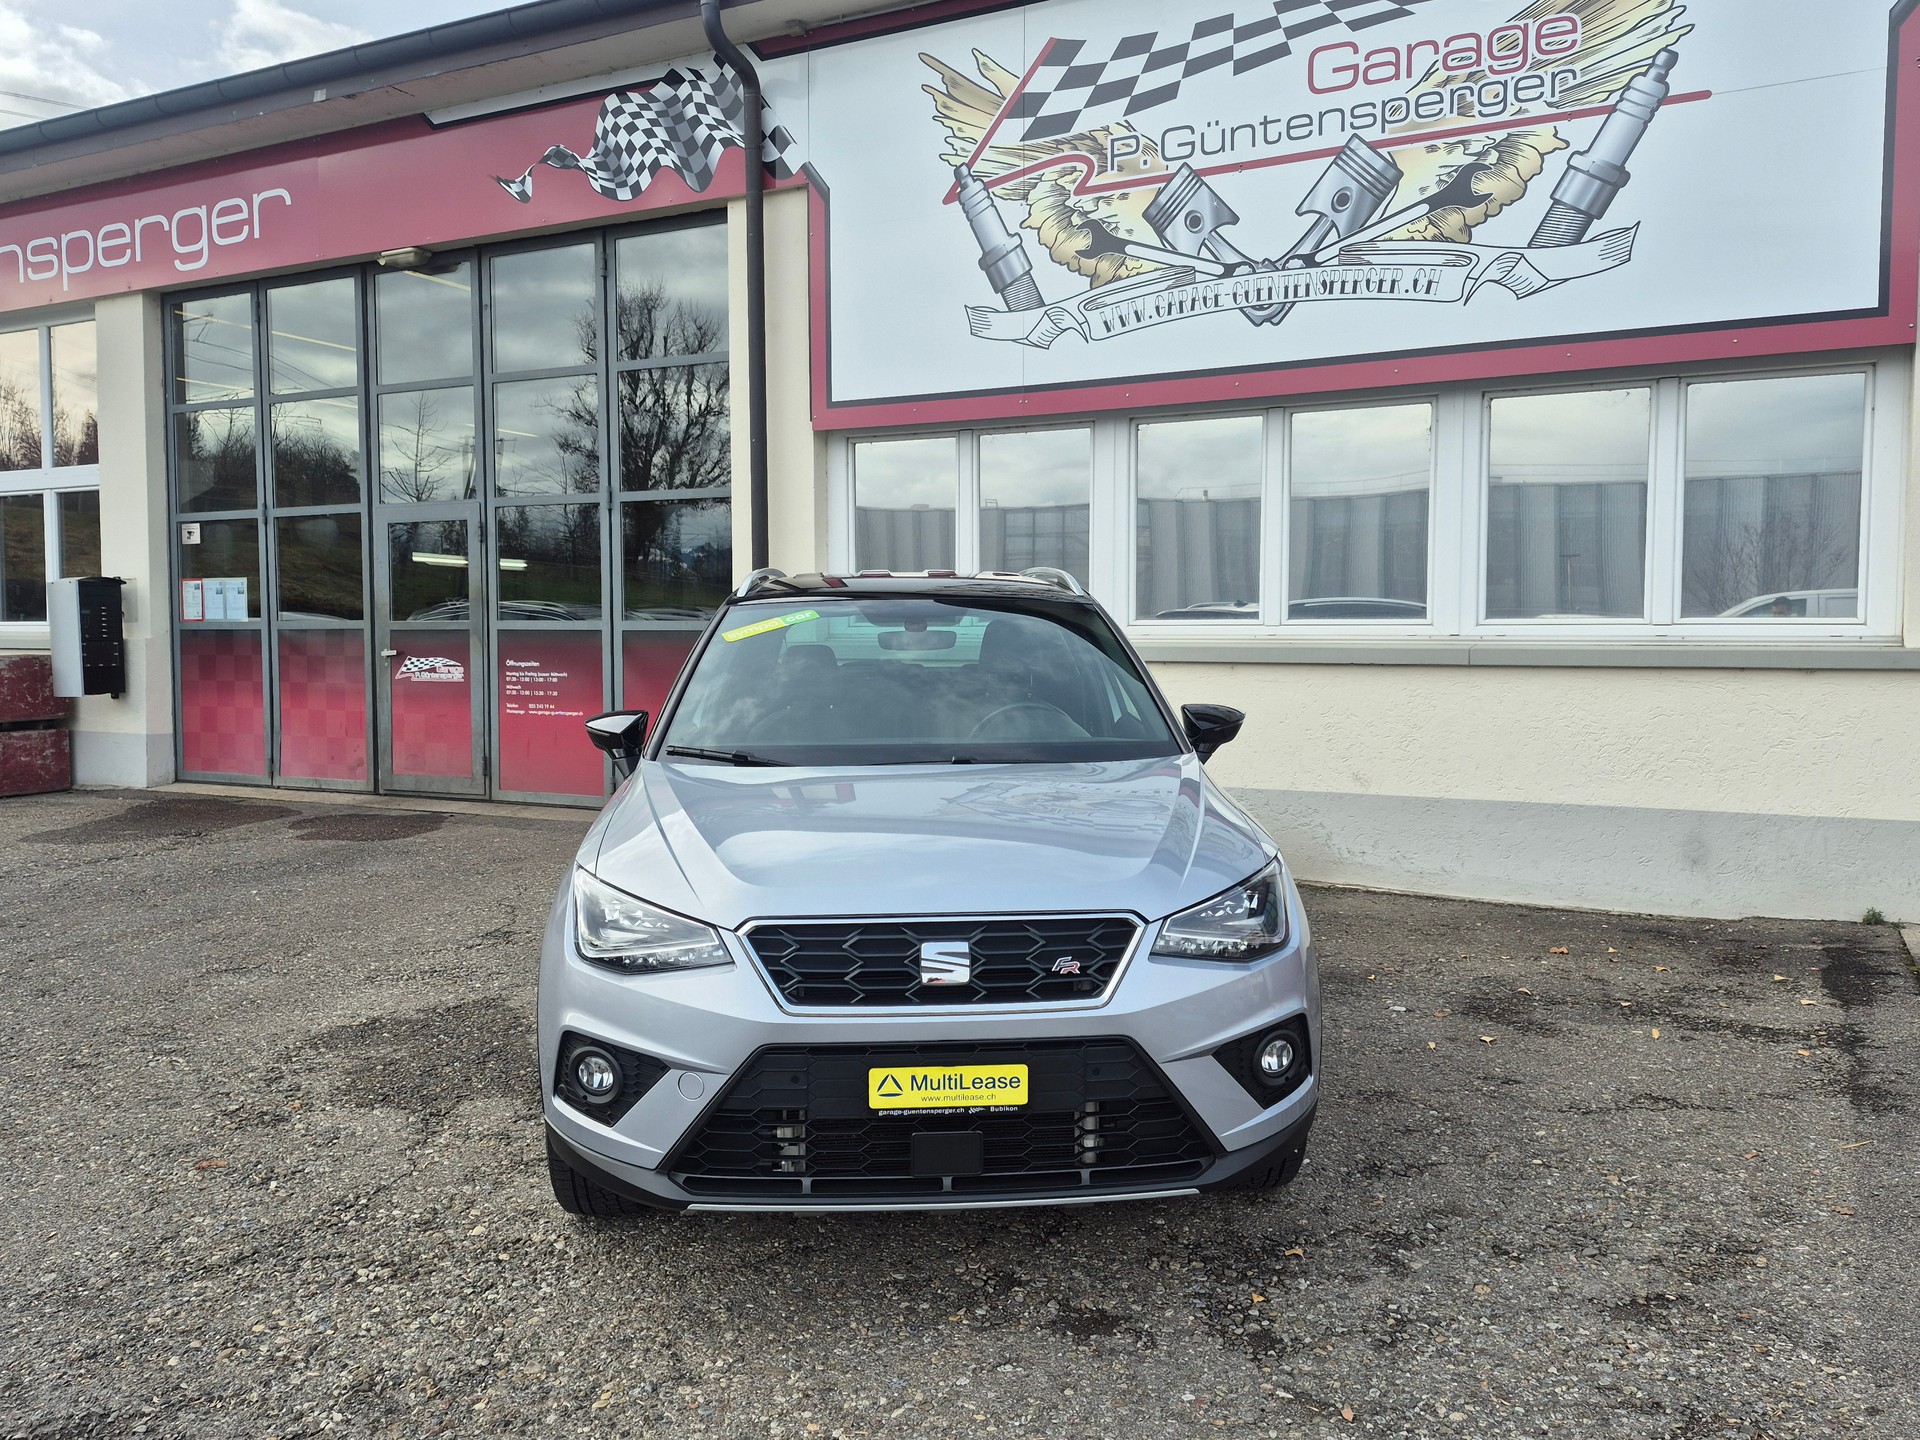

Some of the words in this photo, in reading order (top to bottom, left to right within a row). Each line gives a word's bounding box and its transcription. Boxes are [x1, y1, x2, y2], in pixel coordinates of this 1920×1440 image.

[1307, 14, 1579, 95] Garage
[1109, 133, 1150, 172] P.
[1160, 66, 1578, 160] Güntensperger
[1099, 266, 1444, 334] WWW.GARAGE-GUENTENSPERGER.CH
[785, 611, 813, 623] car
[910, 1073, 1021, 1092] MultiLease
[920, 1093, 997, 1102] www.multilease.ch
